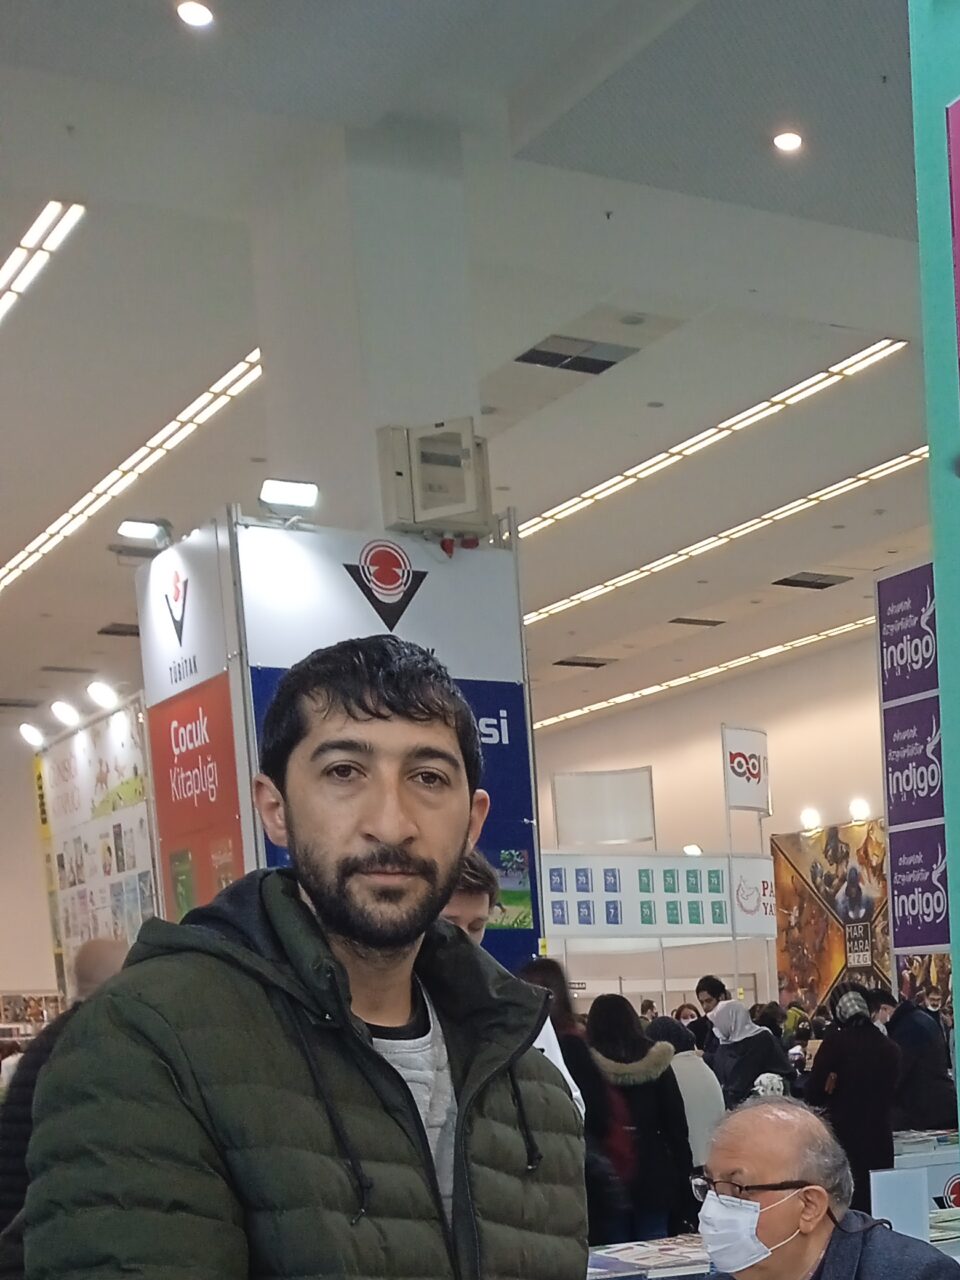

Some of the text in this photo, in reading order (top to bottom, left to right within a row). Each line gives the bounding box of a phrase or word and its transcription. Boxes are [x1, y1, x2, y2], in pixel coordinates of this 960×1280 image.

[883, 634, 935, 671] indigo
[170, 706, 210, 764] Çocuk
[169, 754, 218, 808] Kitaplığı
[888, 762, 941, 798] indigo
[893, 887, 947, 923] indigo
